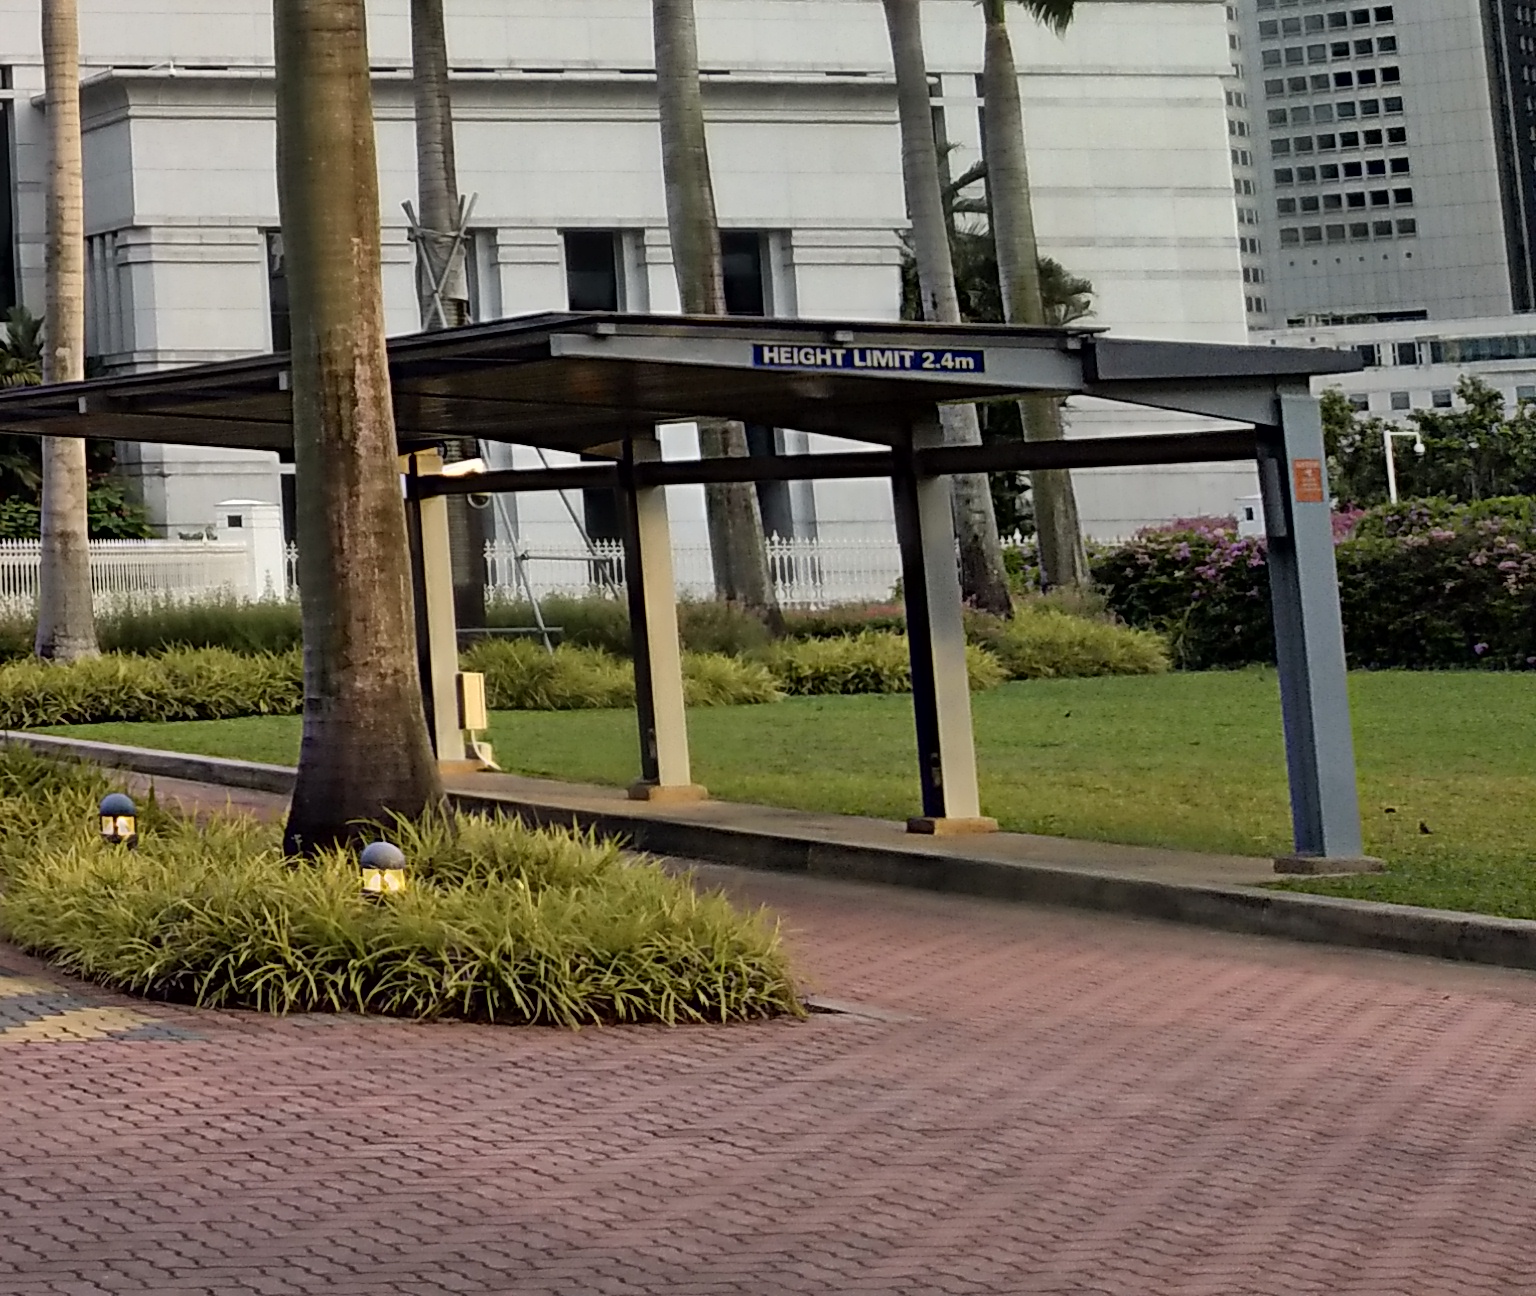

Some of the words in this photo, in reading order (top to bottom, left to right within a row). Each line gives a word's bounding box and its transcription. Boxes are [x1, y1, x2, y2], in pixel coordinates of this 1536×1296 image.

[762, 346, 846, 367] HEIGHT
[853, 349, 914, 368] LIMIT
[921, 352, 974, 369] 2.4m
